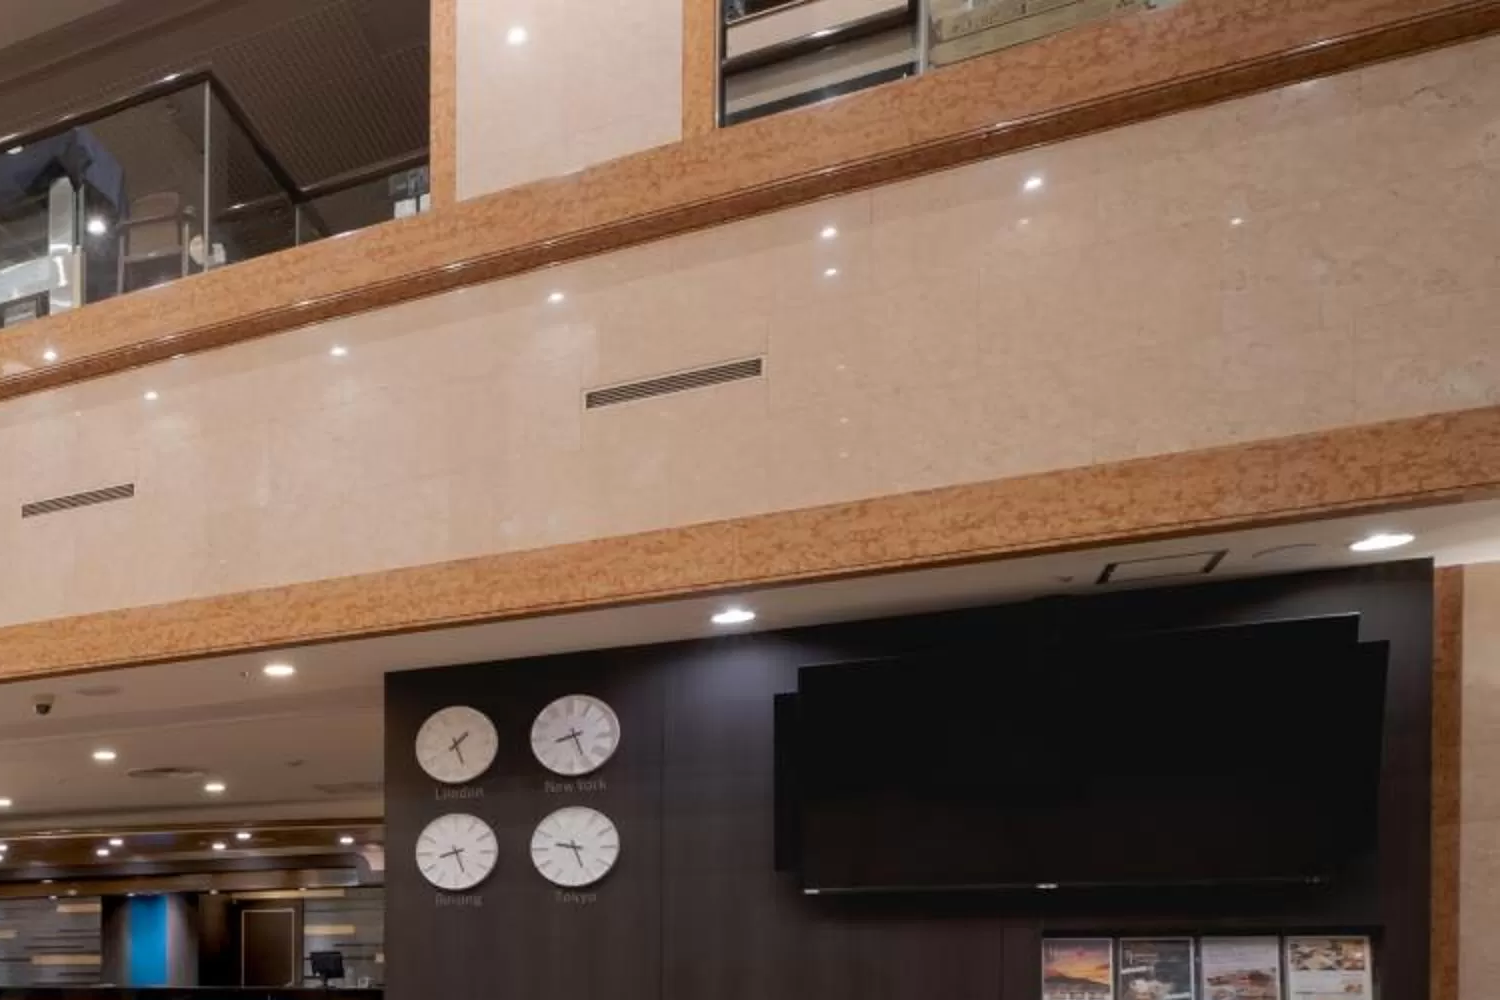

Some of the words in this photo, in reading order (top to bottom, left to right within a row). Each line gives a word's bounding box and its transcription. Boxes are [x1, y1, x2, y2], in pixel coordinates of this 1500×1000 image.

[543, 780, 576, 792] New
[577, 778, 607, 792] York
[435, 786, 484, 800] London
[554, 891, 597, 905] Tokyo
